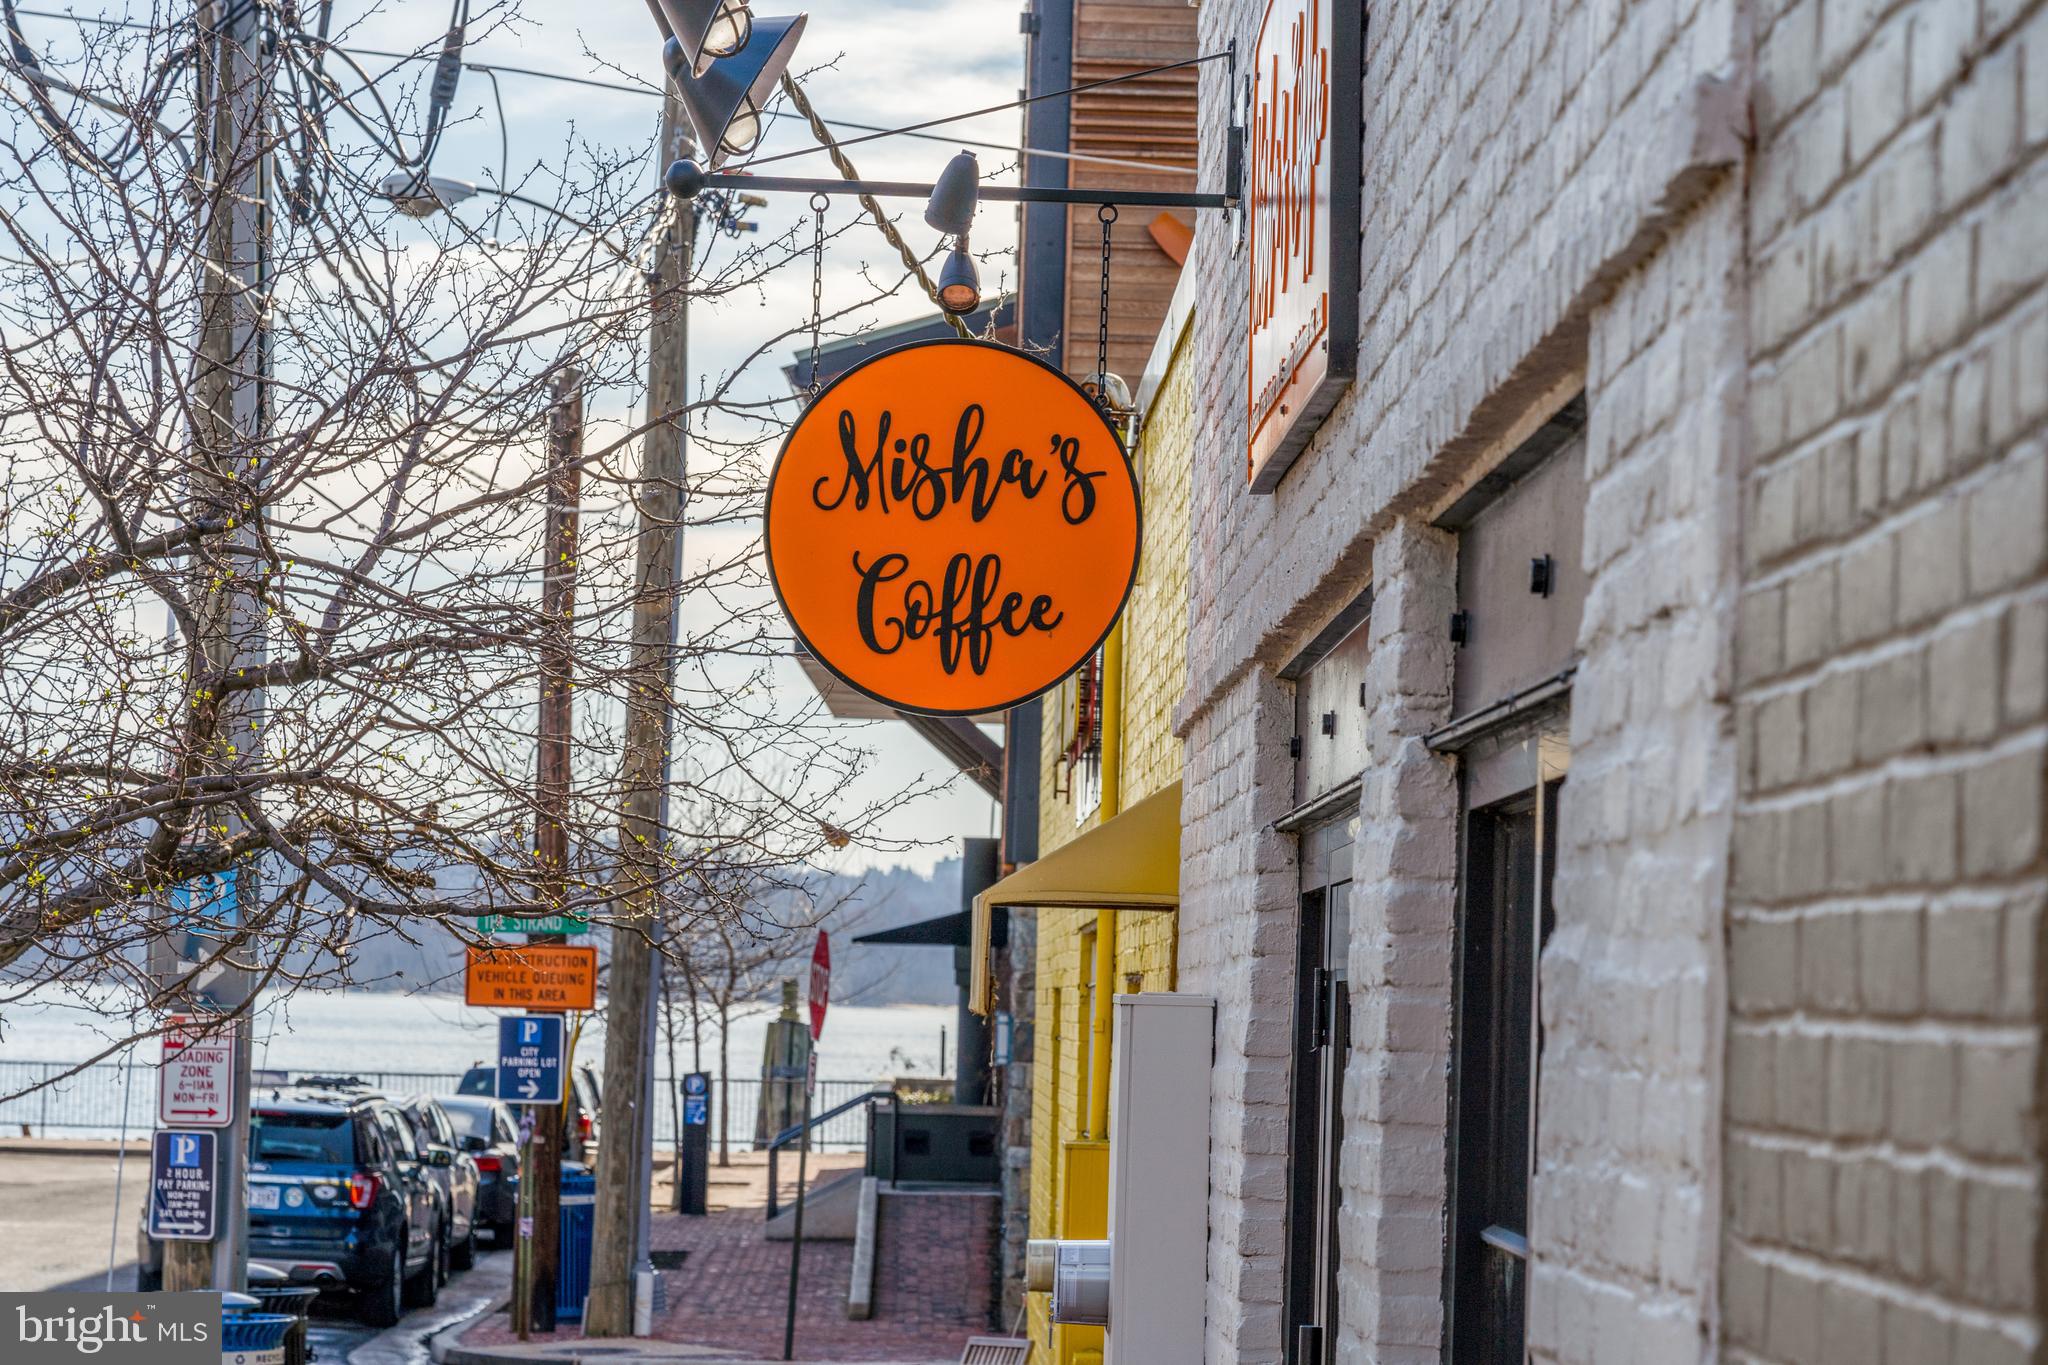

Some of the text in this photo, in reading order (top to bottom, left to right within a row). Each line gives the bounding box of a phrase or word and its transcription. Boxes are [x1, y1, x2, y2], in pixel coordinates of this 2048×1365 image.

[812, 403, 1107, 525] Misha's
[852, 550, 1064, 676] Coffee
[513, 915, 562, 931] STRAND
[477, 971, 585, 985] VEHICLE QUEUING
[494, 988, 566, 1001] IN THIS AREA
[523, 1020, 538, 1042] P
[171, 1050, 224, 1063] LOADING
[520, 1047, 539, 1057] CITY
[502, 1056, 557, 1068] PARKING LOT
[180, 1065, 213, 1078] ZONE
[517, 1067, 541, 1078] OPEN
[173, 1091, 219, 1103] MON-FRI
[175, 1136, 196, 1164] P
[166, 1168, 203, 1179] 2 HOUR
[157, 1179, 210, 1191] PAY PARKING
